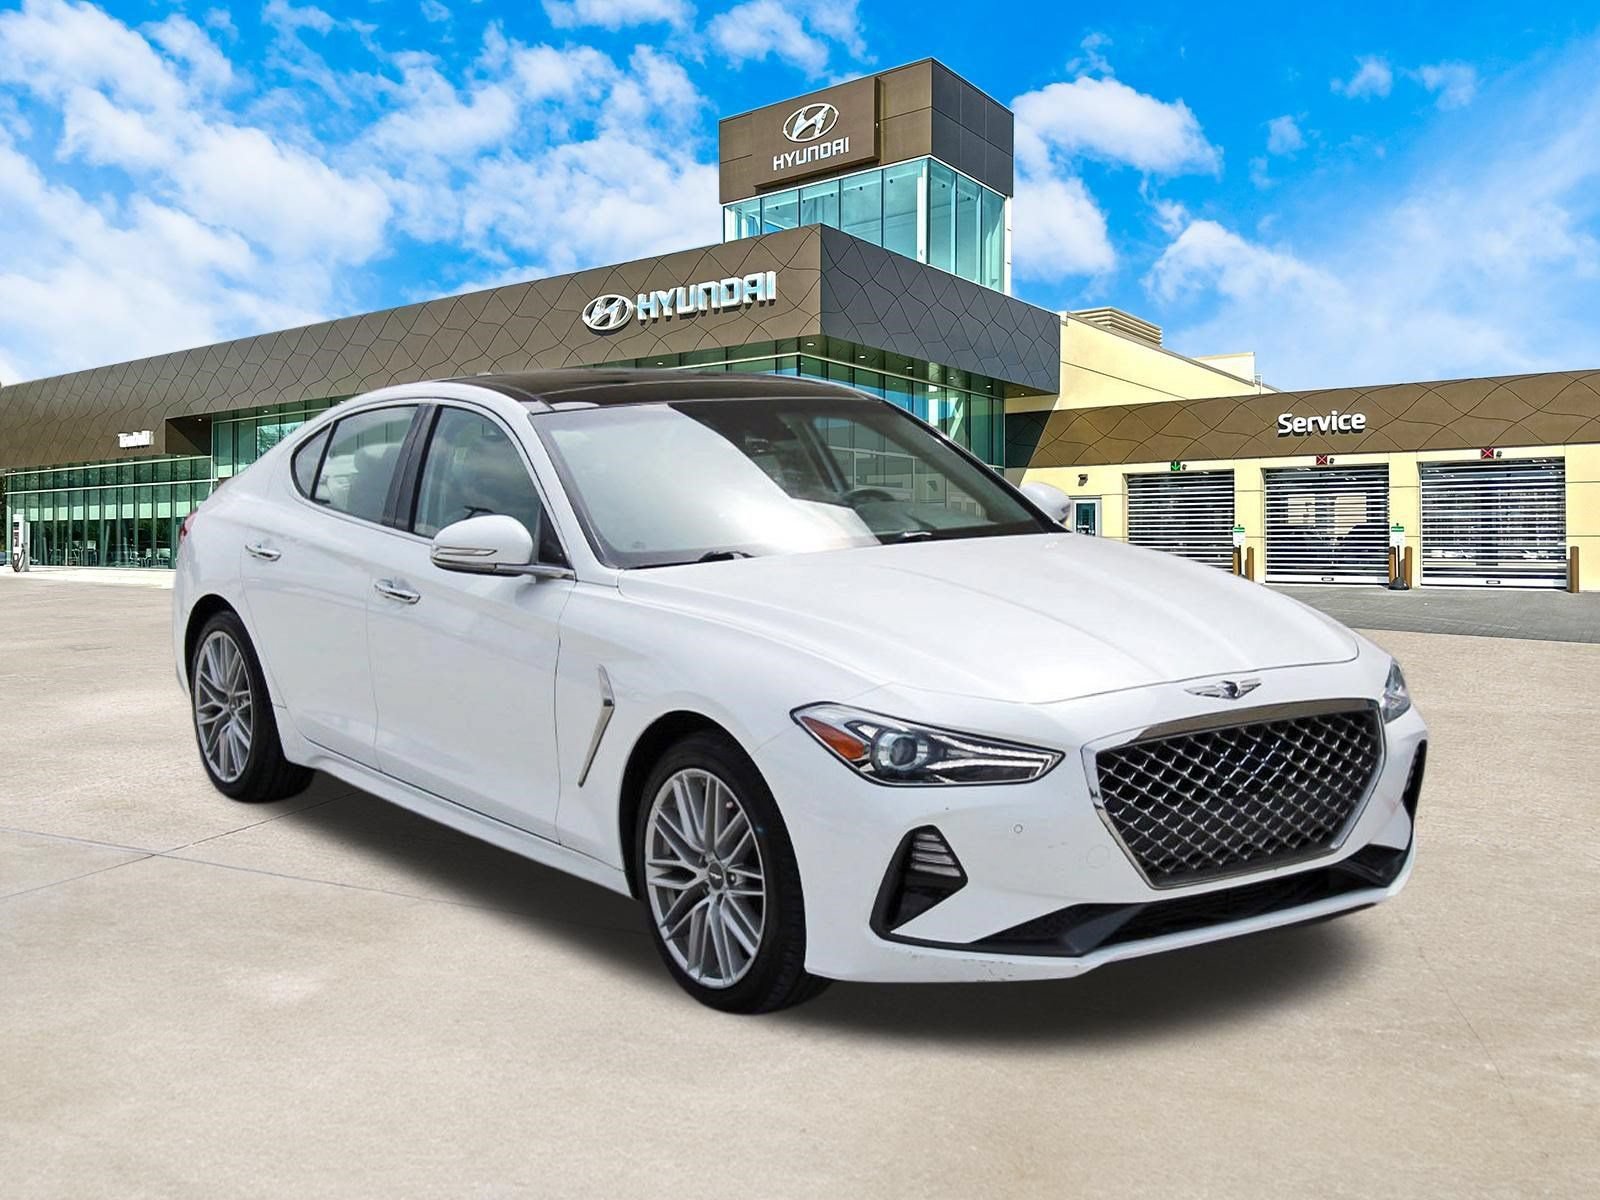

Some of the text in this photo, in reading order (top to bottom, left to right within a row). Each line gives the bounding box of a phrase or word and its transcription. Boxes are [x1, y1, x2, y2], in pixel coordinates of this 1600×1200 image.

[773, 136, 849, 171] HYUNDAI
[637, 271, 777, 321] HYUNDAI
[1277, 410, 1366, 434] Service
